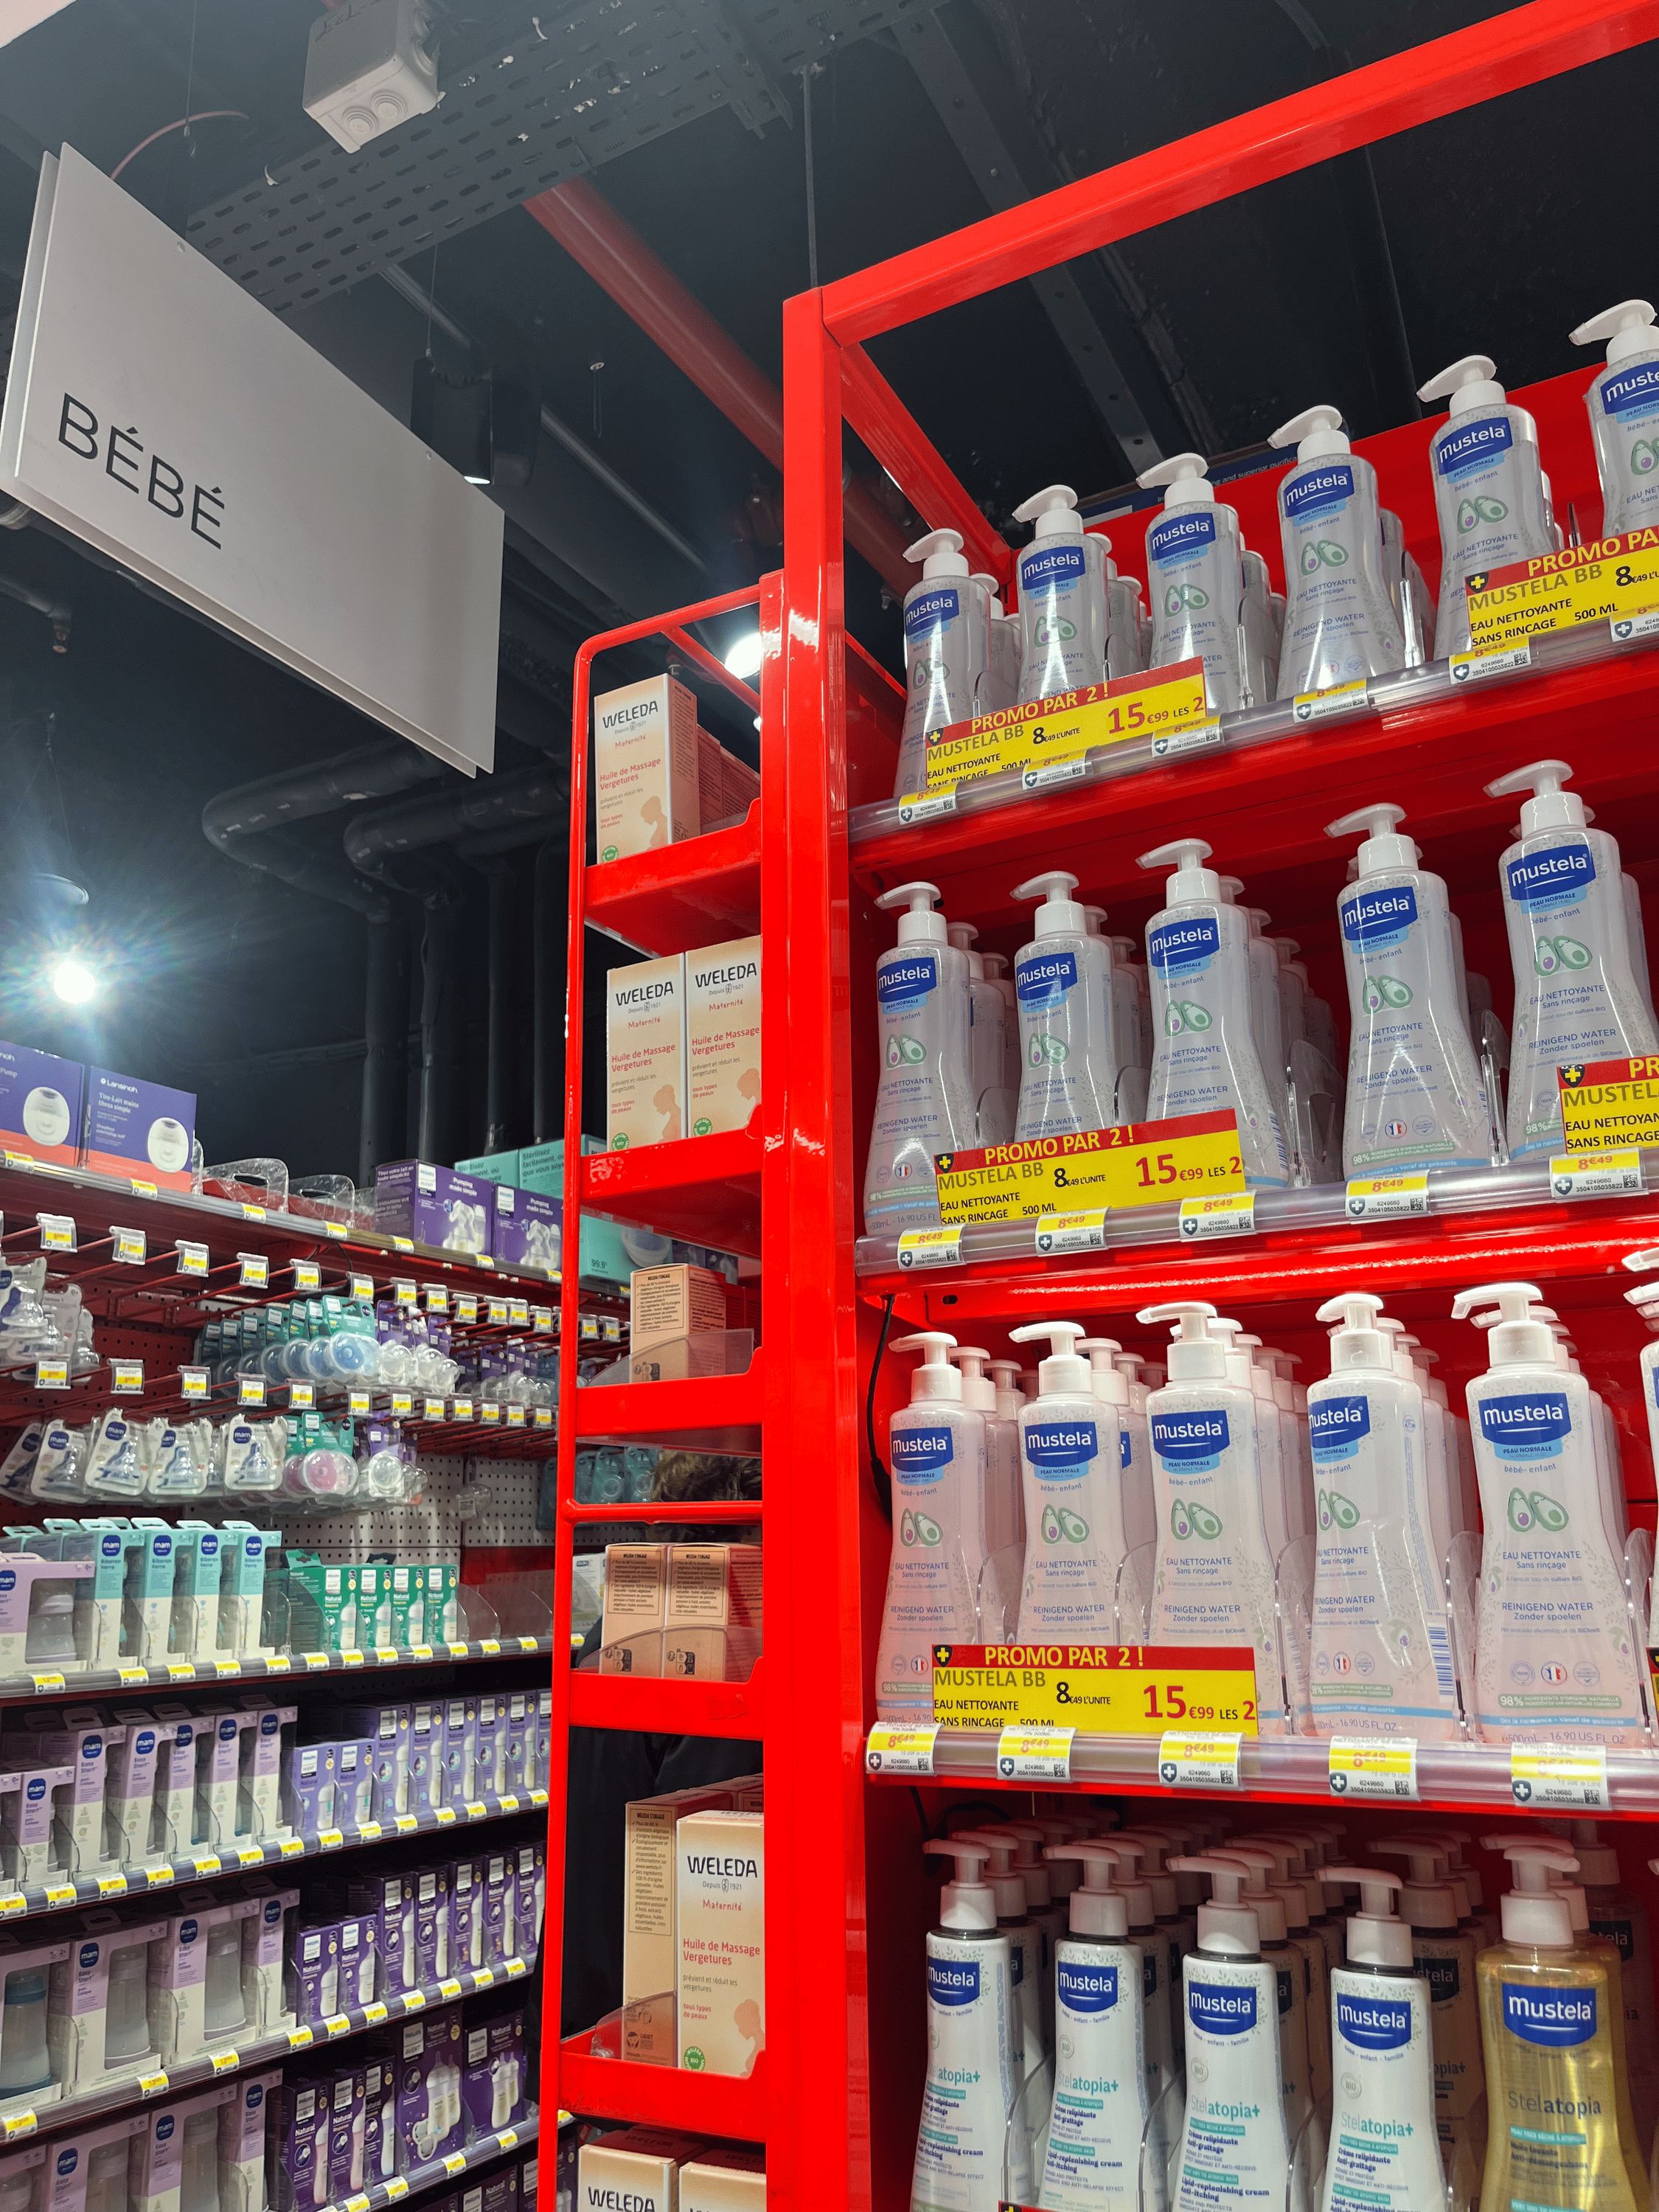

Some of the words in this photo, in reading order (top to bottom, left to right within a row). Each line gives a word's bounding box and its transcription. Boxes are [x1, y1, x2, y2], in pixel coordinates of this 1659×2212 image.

[1439, 425, 1506, 463] mustela
[58, 392, 225, 550] BÉBÉ
[1286, 473, 1348, 504] mustela
[1152, 521, 1210, 550] mustela
[1467, 533, 1518, 552] NETTOYANTE
[1023, 554, 1079, 580] mustela
[1528, 538, 1621, 577] PROMO
[1470, 574, 1568, 611] MUSTELA
[1575, 564, 1602, 584] BB
[905, 596, 953, 627] mustela
[1471, 619, 1493, 632] EAU
[1497, 599, 1572, 624] NETTOYANTE
[1472, 633, 1502, 647] SANS
[1505, 618, 1557, 639] RINCAGE
[1574, 608, 1596, 621] 500
[1599, 602, 1618, 613] ML
[602, 700, 658, 728] WELEDA
[971, 703, 1038, 734] PROMO
[1043, 692, 1077, 714] PAR
[1087, 687, 1097, 702] 2
[928, 731, 999, 761] MUSTELA
[1004, 725, 1024, 741] BB
[1174, 707, 1189, 717] LES
[1193, 696, 1204, 712] 2
[615, 734, 646, 748] Maternité
[599, 771, 618, 782] Huile
[630, 758, 661, 773] Massage
[928, 768, 945, 779] EAU
[946, 754, 1001, 776] NETTOYANTE
[599, 774, 639, 790] Vergetures
[1512, 855, 1588, 886] mustela
[1345, 897, 1409, 927] mustela
[1152, 928, 1213, 954] mustela
[695, 962, 757, 988] WELEDA
[879, 967, 931, 990] mustela
[1018, 962, 1071, 988] mustela
[616, 981, 673, 1006] WELEDA
[1545, 984, 1605, 1003] NETTOYANTE
[709, 999, 743, 1011] Maternité
[628, 1017, 661, 1029] Maternité
[692, 1036, 712, 1046] Huile
[726, 1026, 759, 1040] Massage
[1528, 1032, 1576, 1051] REINIGEND
[1578, 1028, 1617, 1043] WATER
[692, 1041, 735, 1056] Vergetures
[1564, 1082, 1659, 1107] MUSTEL
[1566, 1120, 1590, 1131] EAU
[984, 1137, 1058, 1165] PROMO
[1063, 1132, 1100, 1152] PAR
[1110, 1128, 1122, 1145] 2
[1567, 1137, 1600, 1149] SANS
[939, 1166, 1016, 1190] MUSTELA
[1022, 1162, 1044, 1178] BB
[1208, 1166, 1226, 1178] LES
[1230, 1156, 1242, 1175] 2
[1579, 1156, 1613, 1170] 8€49
[940, 1199, 959, 1211] EAU
[961, 1192, 1020, 1208] NETTOYANTE
[942, 1214, 965, 1225] SANS
[967, 1208, 1008, 1222] RINCAGE
[1022, 1205, 1040, 1215] 500
[1042, 1203, 1057, 1214] ML
[1484, 1404, 1564, 1426] mustela
[108, 1425, 125, 1436] mam
[1155, 1422, 1222, 1439] mustela
[894, 1437, 947, 1453] mustela
[1028, 1433, 1091, 1449] mustela
[1530, 1462, 1557, 1472] enfant
[1503, 1551, 1517, 1560] EAU
[1520, 1551, 1581, 1560] NETTOYANTE
[1517, 1561, 1534, 1569] Sans
[1536, 1559, 1566, 1571] rinçage
[1502, 1601, 1554, 1611] REINIGEND
[1557, 1601, 1593, 1611] WATER
[1514, 1612, 1543, 1621] Zonder
[1546, 1611, 1582, 1622] spoelen
[986, 1647, 1062, 1666] PROMO
[1068, 1647, 1107, 1666] PAR
[1119, 1647, 1132, 1666] 2
[935, 1670, 1017, 1686] MUSTELA
[1023, 1672, 1046, 1687] BB
[1220, 1709, 1238, 1720] LES
[1242, 1700, 1256, 1720] 2
[1500, 1696, 1523, 1706] 98%
[934, 1700, 954, 1710] EAU
[956, 1700, 1019, 1711] NETTOYANTE
[934, 1717, 959, 1727] SANS
[961, 1717, 1005, 1728] RINCAGE
[1551, 1732, 1576, 1741] 16.90
[1579, 1733, 1593, 1742] US
[687, 1856, 757, 1878] WELEDA
[703, 1882, 720, 1890] Depuis
[703, 1899, 742, 1911] Maternité
[80, 1952, 98, 1960] mam
[683, 1938, 706, 1950] Huile
[708, 1941, 719, 1952] de
[722, 1942, 760, 1955] Massage
[683, 1950, 732, 1965] Vergetures
[684, 1975, 704, 1985] prévient
[712, 1977, 728, 1985] réduit
[928, 1966, 974, 1986] mustela
[1060, 1972, 1112, 1992] mustela
[684, 1983, 712, 1992] vergetures
[695, 2005, 712, 2013] types
[1191, 1992, 1251, 2014] mustela
[1509, 1996, 1591, 2020] mustela
[684, 2010, 690, 2018] de
[691, 2011, 708, 2020] peaux
[1340, 2004, 1406, 2029] mustela
[1509, 2090, 1601, 2119] Stelatopia
[296, 2124, 315, 2136] Natural
[588, 2186, 655, 2212] WELEDA
